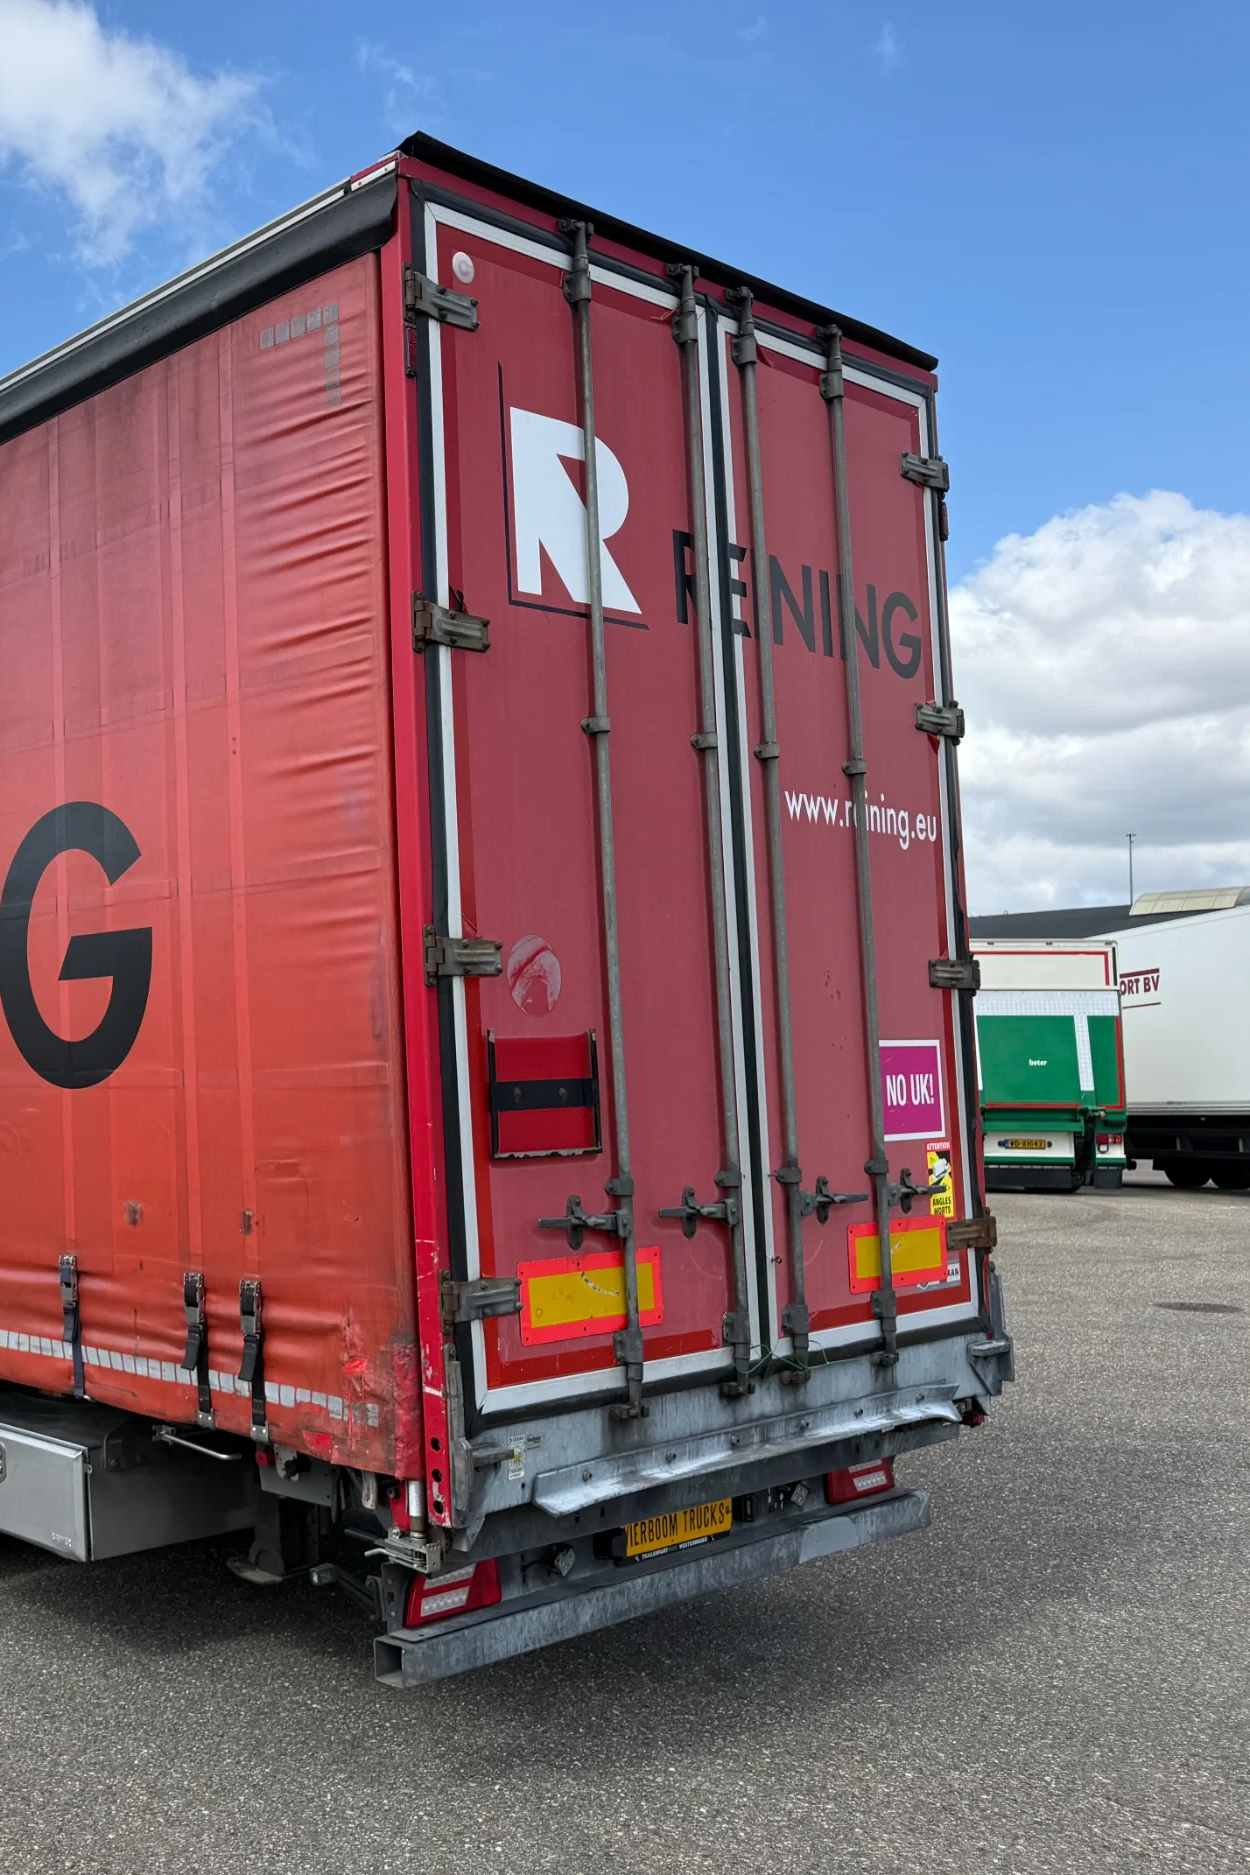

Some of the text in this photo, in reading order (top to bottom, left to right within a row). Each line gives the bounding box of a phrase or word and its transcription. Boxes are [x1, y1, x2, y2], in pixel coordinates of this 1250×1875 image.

[510, 406, 643, 614] R
[784, 789, 937, 850] www.rining.eu
[1143, 974, 1160, 993] BV
[885, 1073, 935, 1107] NO UK!
[926, 1141, 951, 1151] ATTENTION
[932, 1196, 952, 1207] ANGLES
[934, 1206, 951, 1215] MORTS
[683, 1502, 725, 1533] TRUCKS
